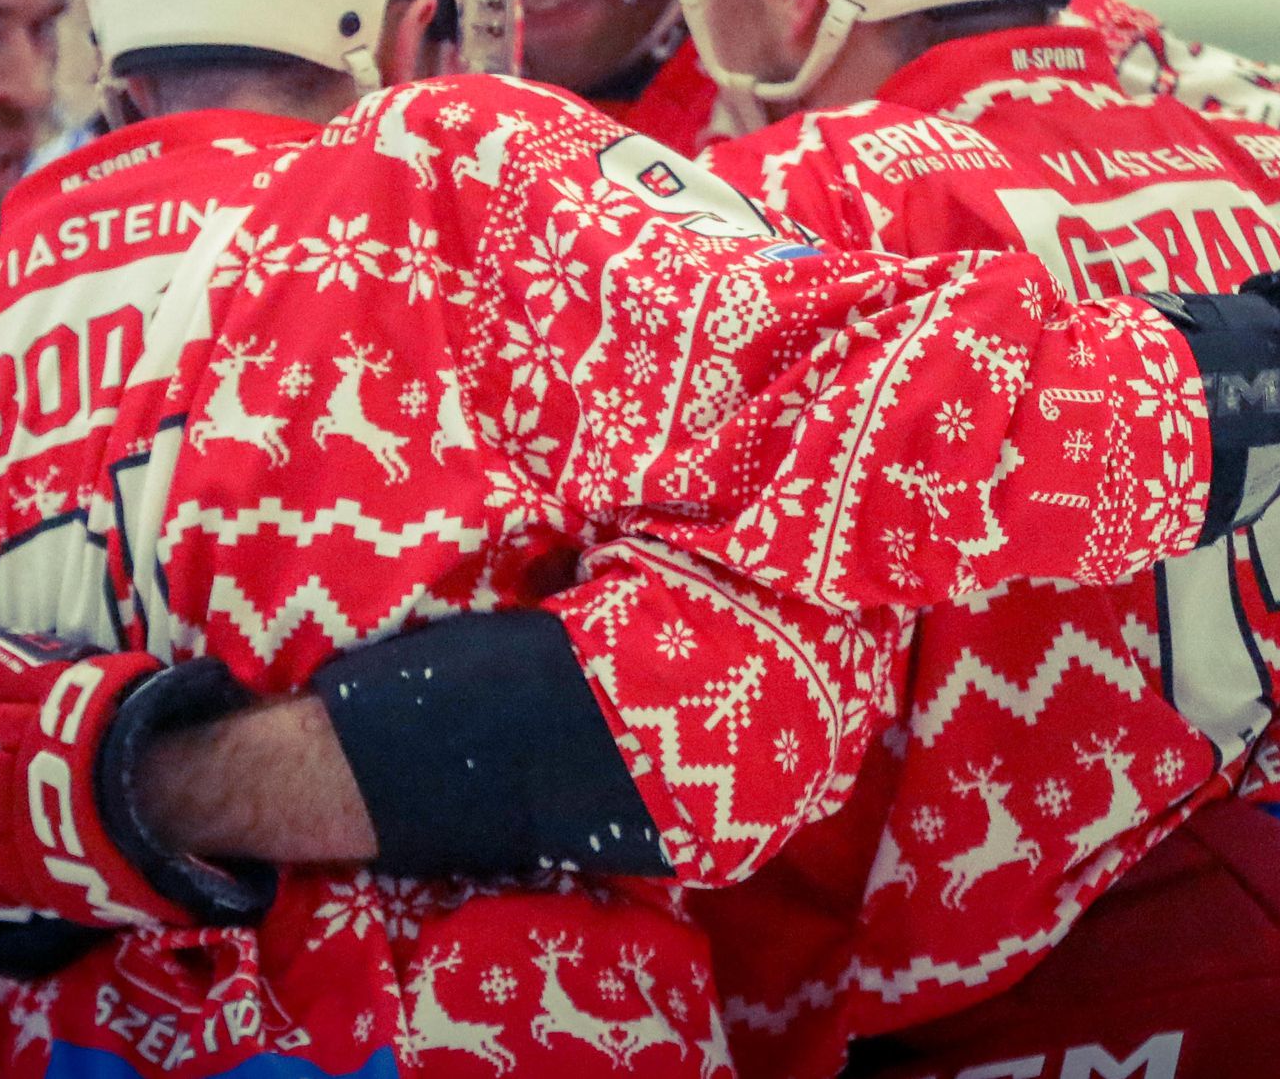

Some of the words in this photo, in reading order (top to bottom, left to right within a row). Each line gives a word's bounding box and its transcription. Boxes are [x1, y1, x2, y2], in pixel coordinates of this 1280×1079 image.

[1011, 47, 1086, 71] M-SPORT
[882, 151, 1013, 184] CONSTRUCT
[1040, 144, 1226, 186] VIASTEIN
[27, 660, 166, 935] CCM
